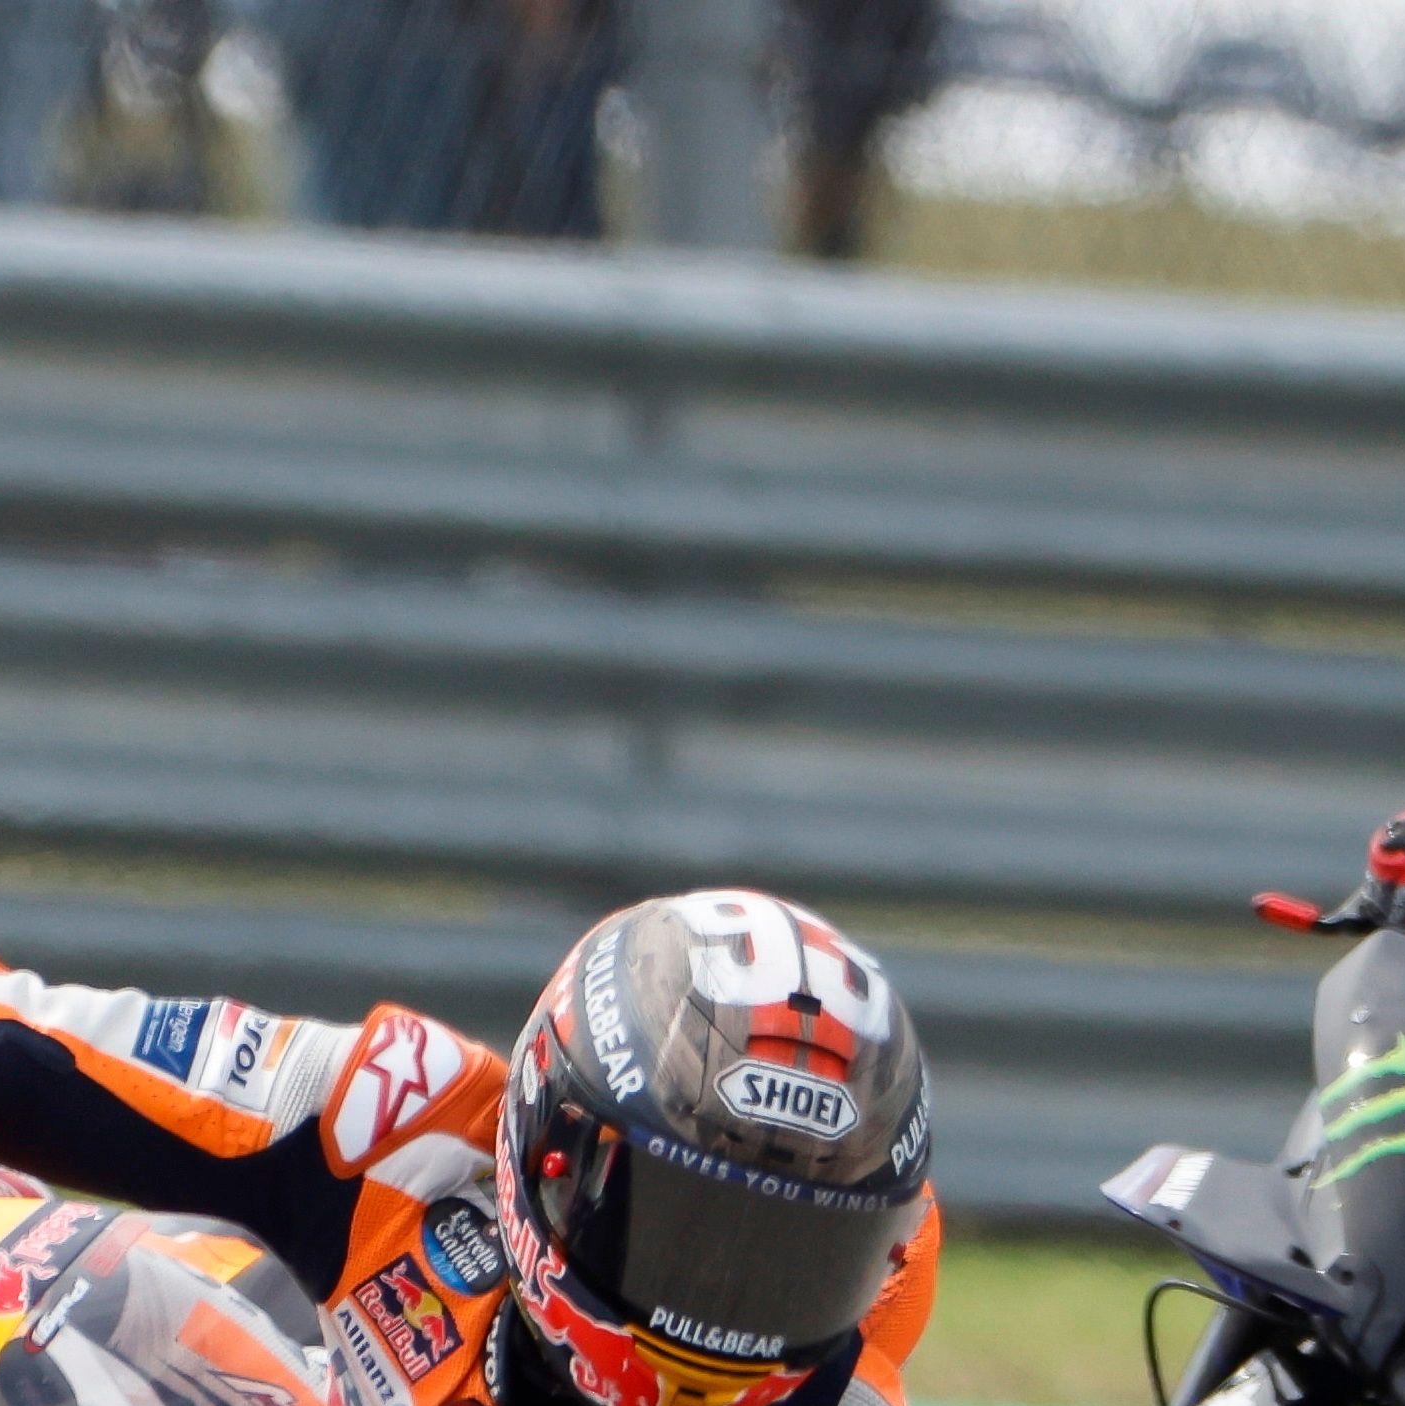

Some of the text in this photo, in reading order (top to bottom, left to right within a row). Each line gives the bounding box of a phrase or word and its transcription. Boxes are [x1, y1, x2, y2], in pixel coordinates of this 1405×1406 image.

[740, 1072, 842, 1128] SHOEI
[649, 1135, 889, 1212] GIVES YOU WINGS
[435, 1222, 480, 1283] Galicia
[451, 1207, 499, 1274] Estrella
[337, 1309, 395, 1404] Allianz
[650, 1306, 785, 1358] PULL&BEAR
